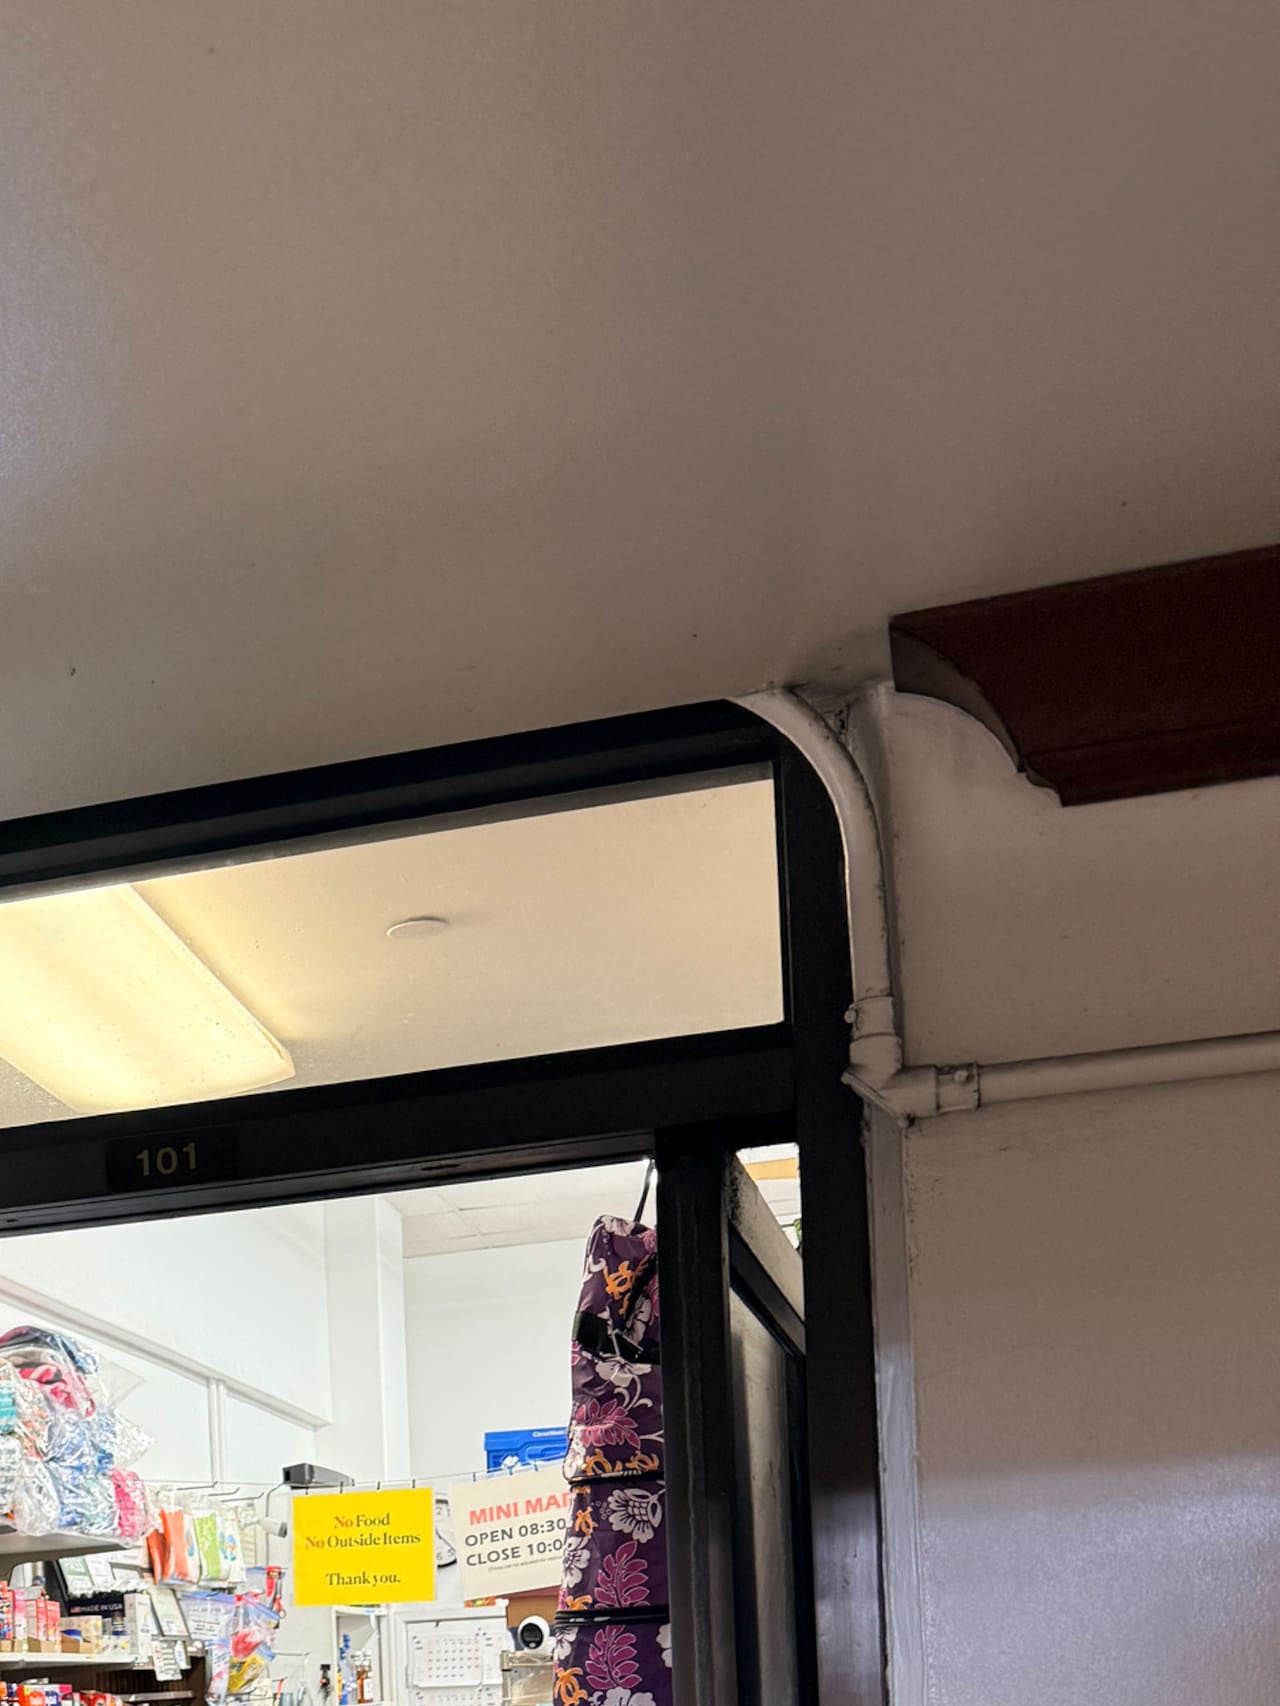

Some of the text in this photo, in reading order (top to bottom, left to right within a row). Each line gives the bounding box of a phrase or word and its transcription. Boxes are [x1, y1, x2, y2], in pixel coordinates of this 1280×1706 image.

[136, 1142, 196, 1176] 101
[334, 1513, 391, 1528] No Food
[469, 1502, 519, 1526] MINI
[305, 1532, 421, 1549] No Outside Items
[465, 1518, 567, 1547] OPEN 08:30
[466, 1546, 521, 1566] CLOSE
[528, 1539, 563, 1556] 10:0
[325, 1571, 401, 1587] Thank you.
